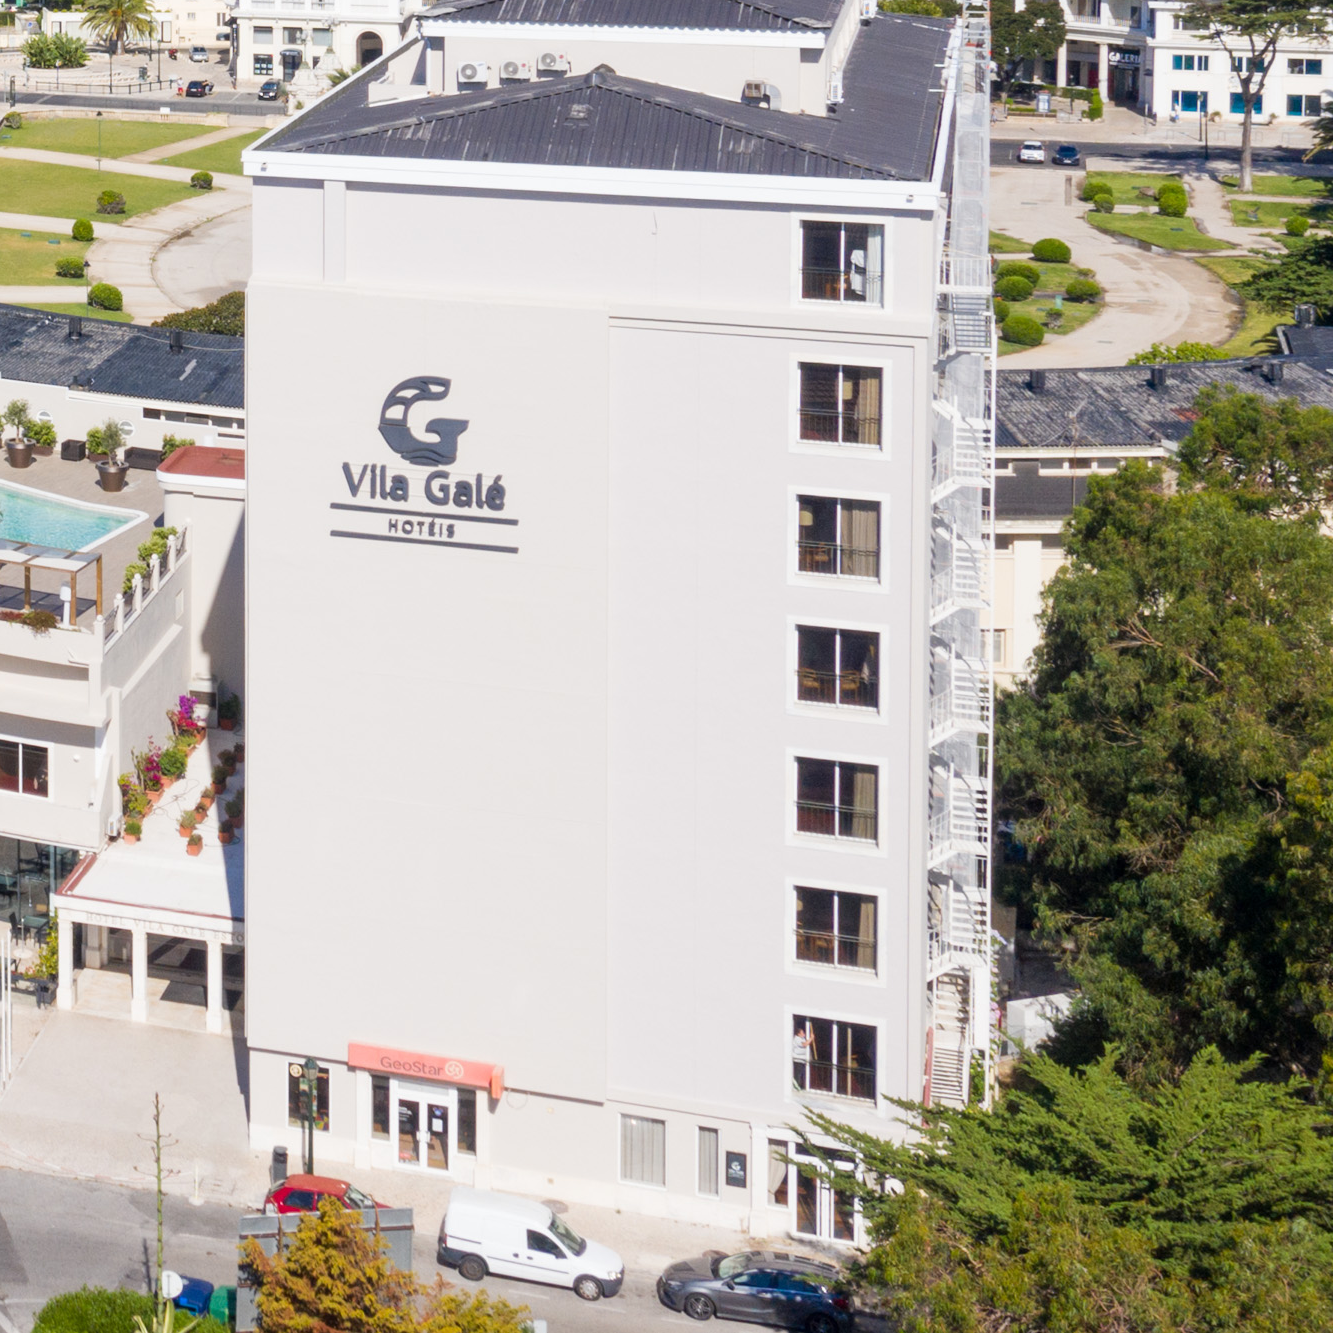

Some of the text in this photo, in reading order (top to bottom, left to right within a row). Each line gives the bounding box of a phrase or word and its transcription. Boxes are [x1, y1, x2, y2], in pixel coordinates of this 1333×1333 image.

[341, 462, 506, 511] Vila Galé
[388, 517, 455, 539] HOTÉIS
[86, 913, 125, 926] HOTEL
[134, 919, 164, 932] VILA
[380, 1056, 443, 1076] GeoStar
